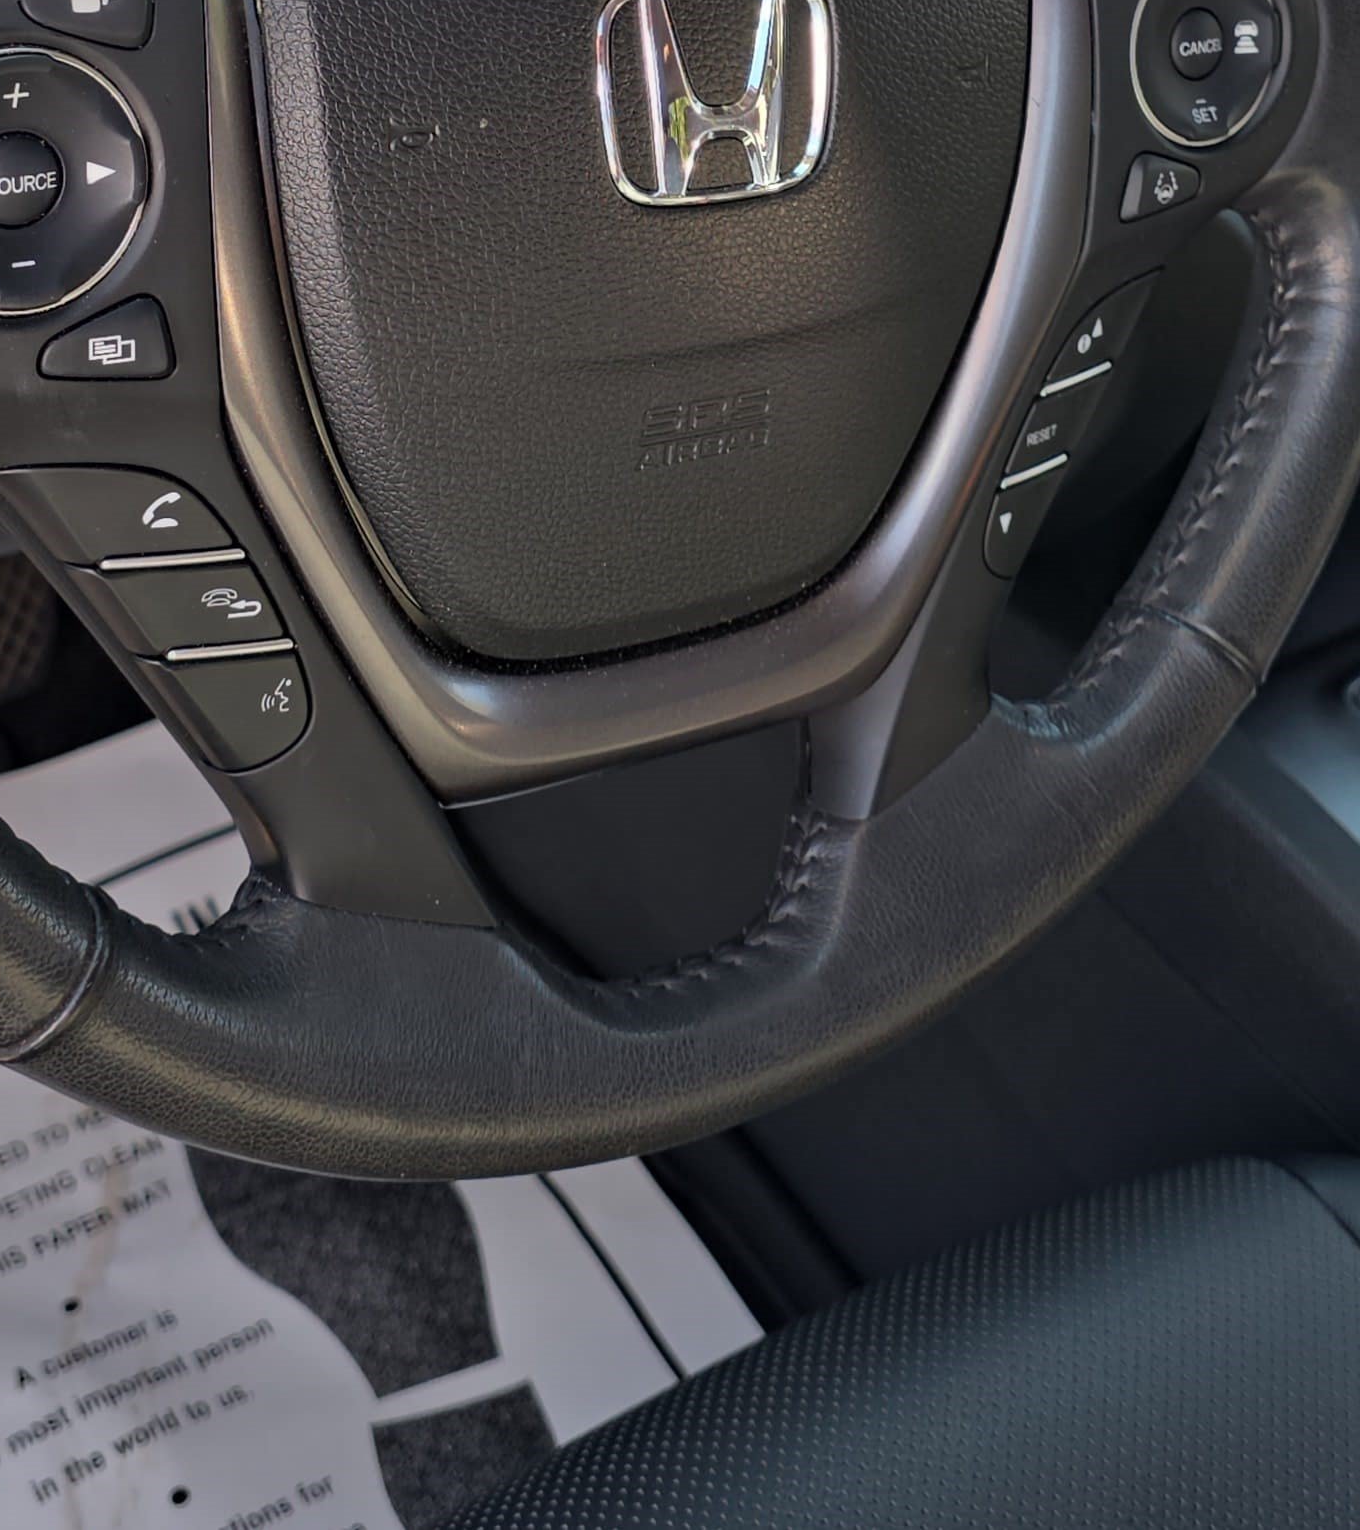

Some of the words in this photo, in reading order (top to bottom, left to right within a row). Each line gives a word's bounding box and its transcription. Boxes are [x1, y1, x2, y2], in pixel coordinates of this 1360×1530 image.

[1179, 38, 1222, 57] CANCEL
[1191, 106, 1218, 124] SET
[1026, 423, 1057, 447] RESET
[33, 1122, 70, 1147] TO
[83, 1136, 164, 1178] CLEAN
[31, 1205, 114, 1255] PAPER
[121, 1178, 172, 1215] MAT
[15, 1367, 37, 1390] A
[41, 1321, 149, 1378] customer
[155, 1309, 179, 1333] is
[6, 1406, 72, 1454] most
[74, 1356, 189, 1418] important
[193, 1318, 276, 1372] person
[30, 1477, 60, 1503] in
[63, 1451, 106, 1484] the
[112, 1408, 181, 1456] world
[184, 1399, 212, 1423] to
[296, 1474, 334, 1504] for
